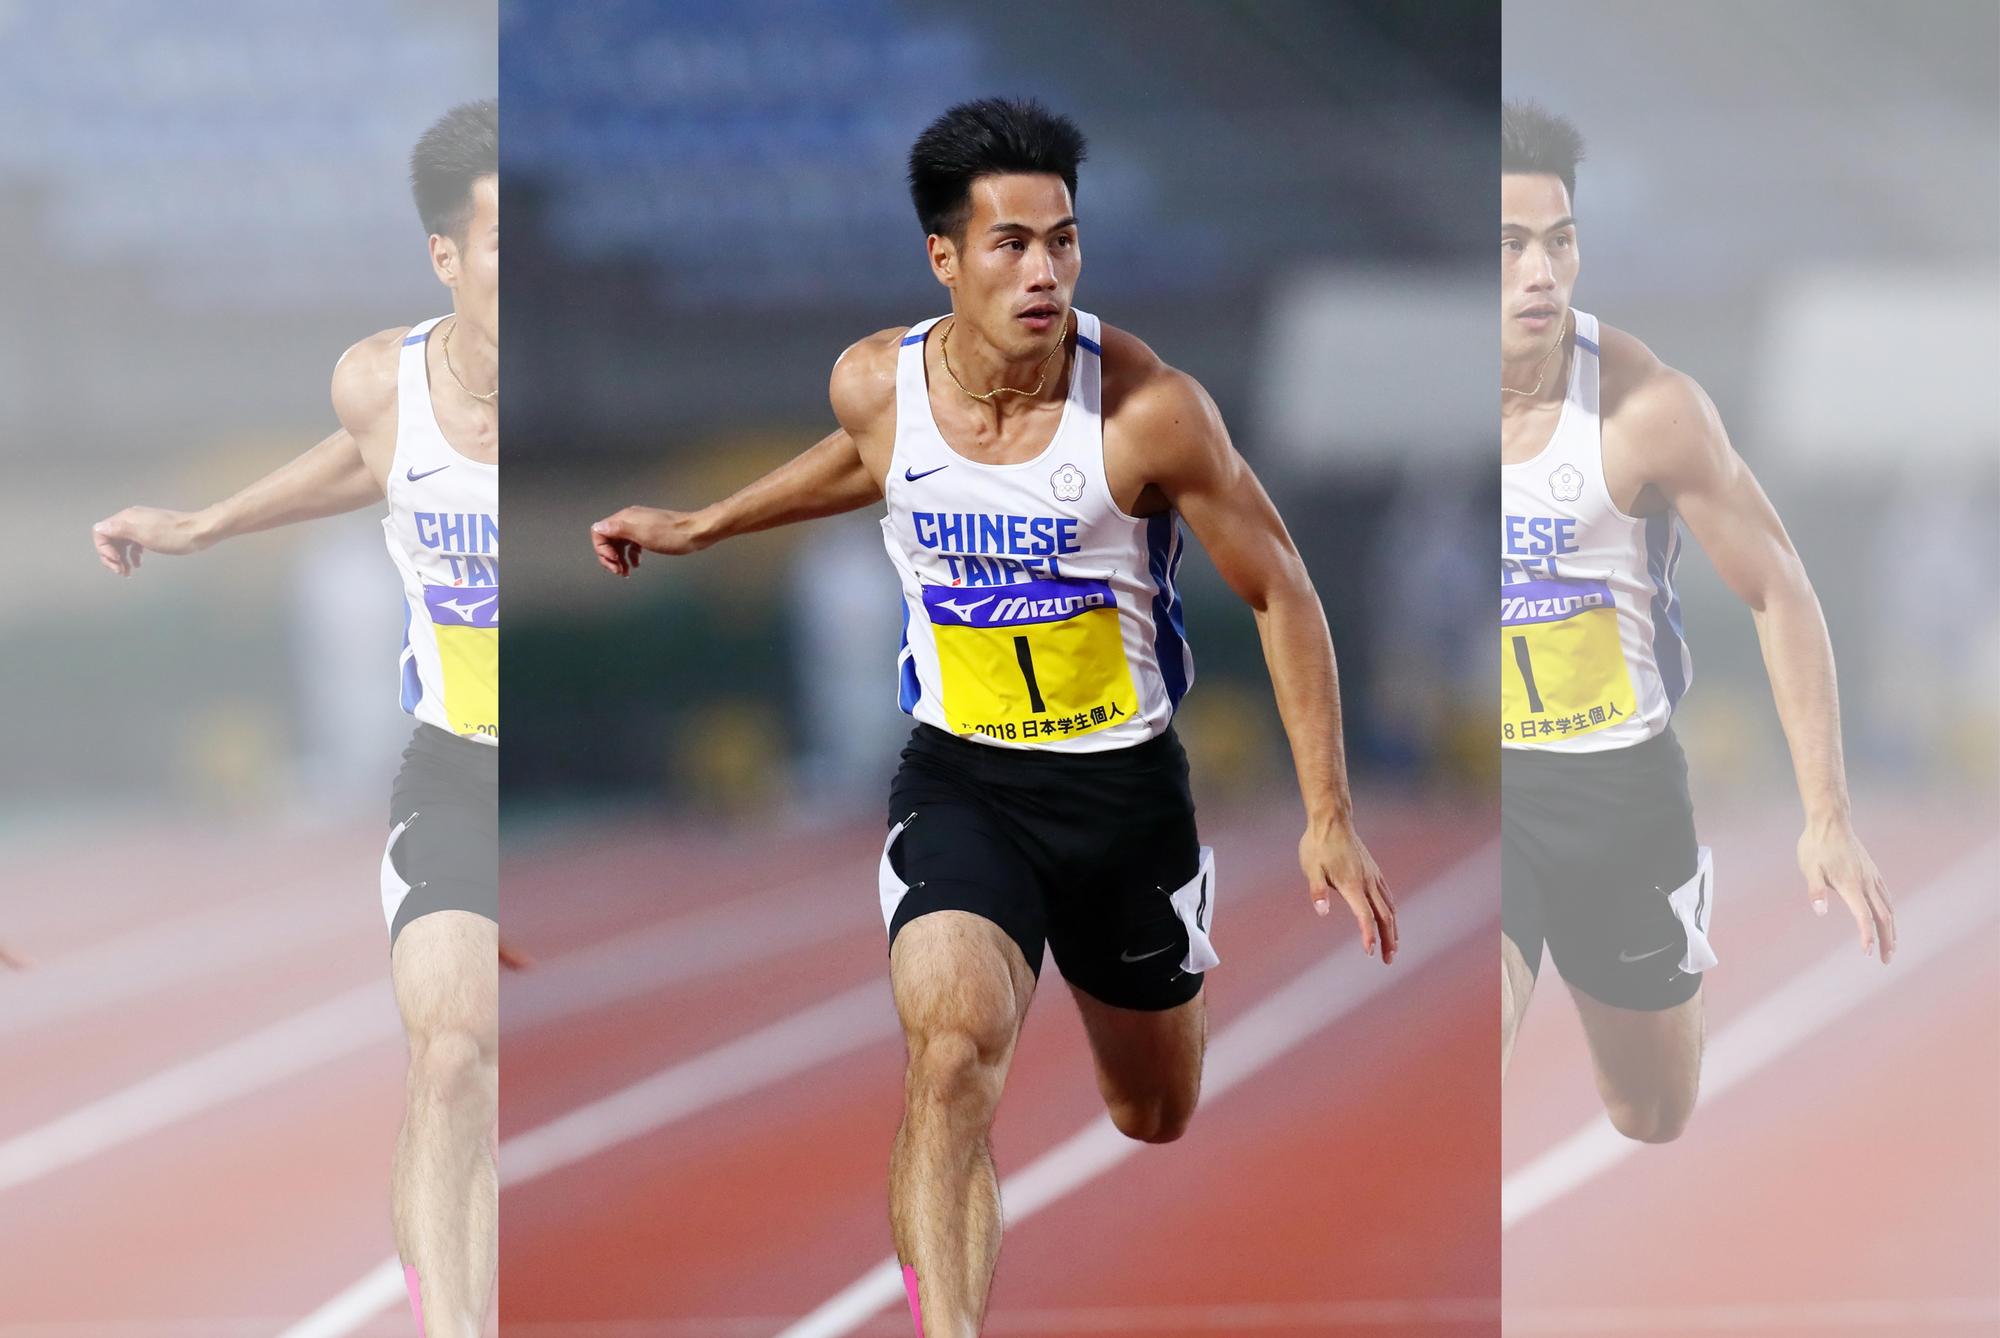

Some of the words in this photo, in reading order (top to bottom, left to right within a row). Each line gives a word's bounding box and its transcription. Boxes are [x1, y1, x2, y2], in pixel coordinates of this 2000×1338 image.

[912, 512, 1081, 556] CHINESE
[938, 554, 1060, 587] TAIPEI
[1013, 636, 1046, 713] 1
[1512, 636, 1544, 713] 1
[1022, 702, 1125, 738] 日本学生個人
[1520, 702, 1623, 738] 日本学生個人
